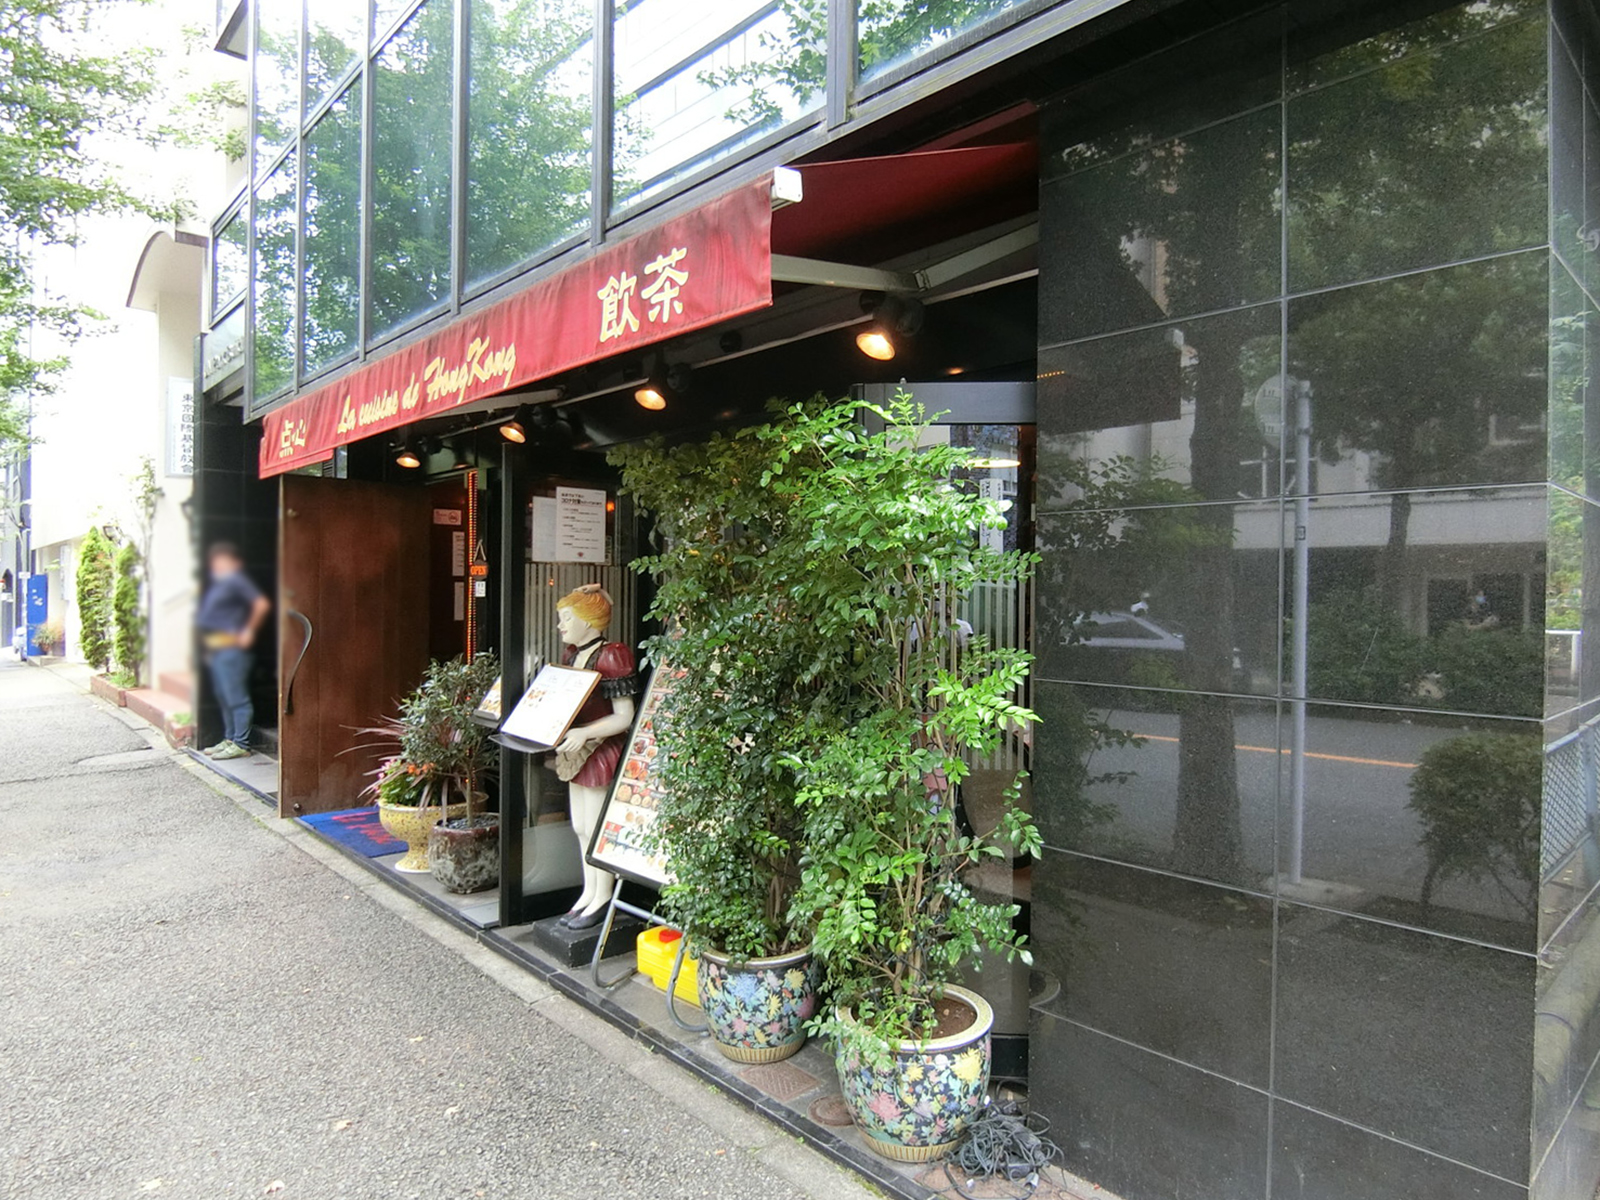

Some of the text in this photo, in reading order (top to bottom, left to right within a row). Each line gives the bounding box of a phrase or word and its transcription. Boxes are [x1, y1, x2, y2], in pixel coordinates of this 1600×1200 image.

[597, 246, 689, 343] 飲茶
[337, 396, 356, 434] La
[359, 390, 398, 426] cuisine
[402, 372, 420, 410] de
[279, 419, 307, 458] 点心
